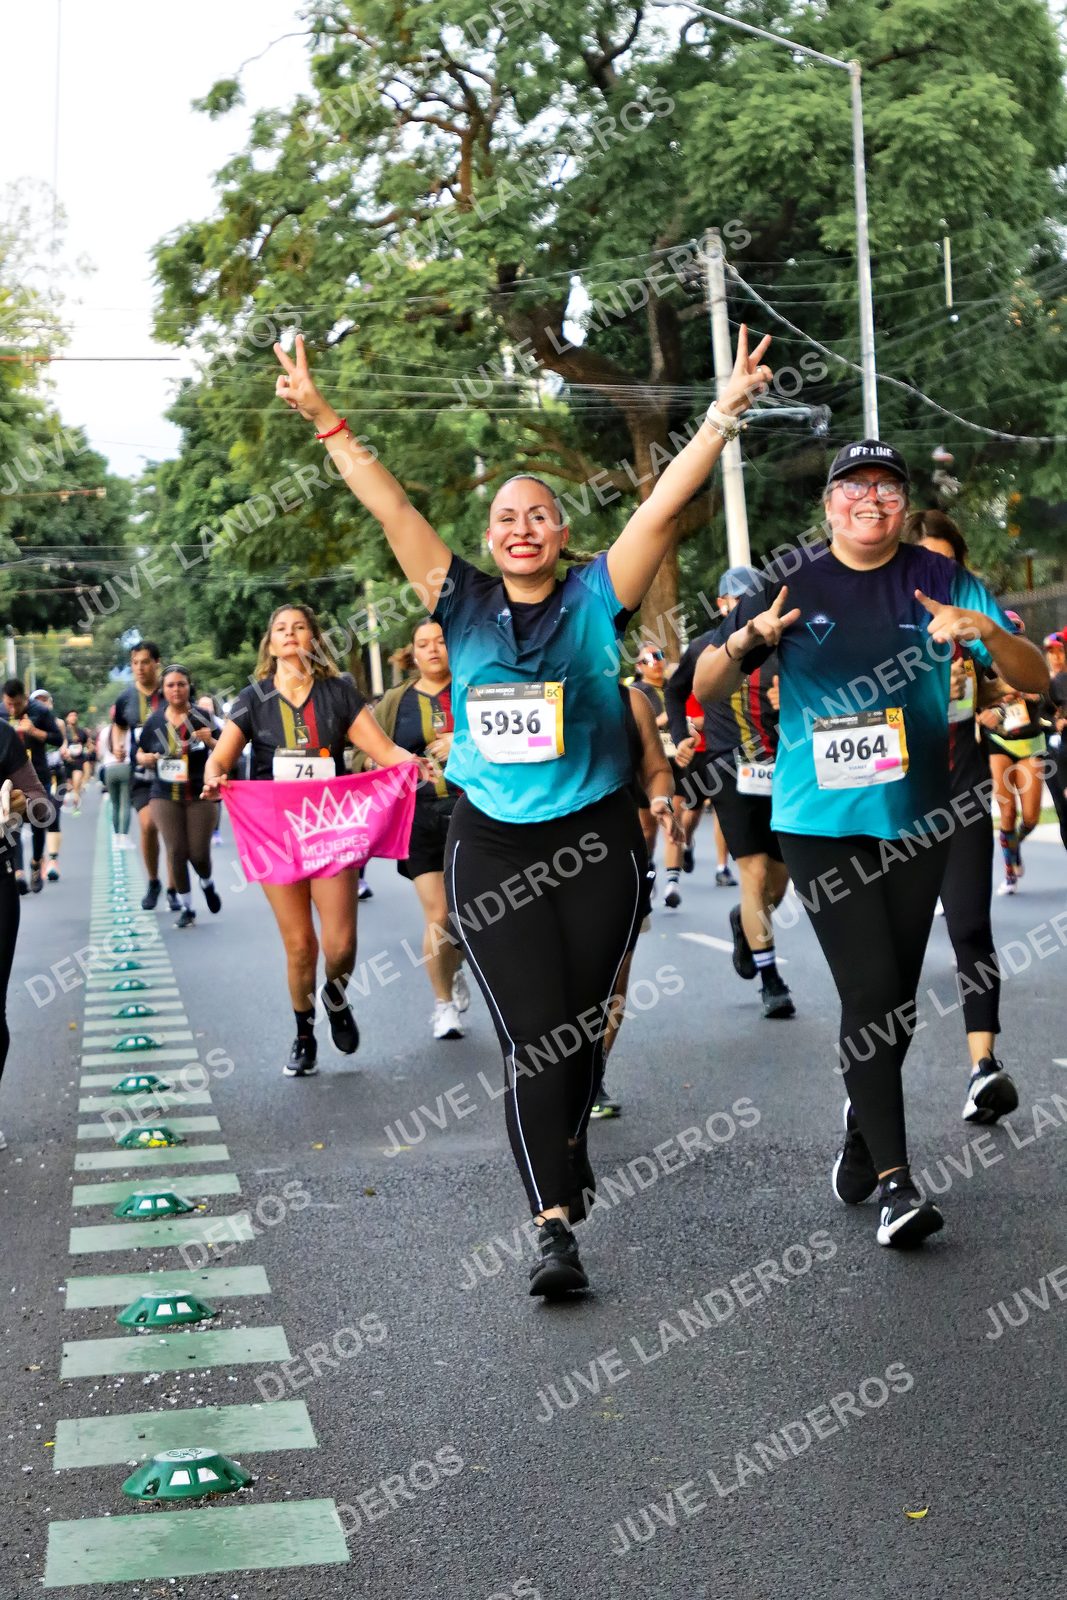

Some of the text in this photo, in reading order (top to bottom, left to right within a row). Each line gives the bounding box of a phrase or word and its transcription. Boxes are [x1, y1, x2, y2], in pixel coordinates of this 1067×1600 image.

[546, 689, 559, 698] 5K
[480, 709, 541, 736] 5936
[825, 735, 888, 763] 4964
[295, 764, 314, 779] 74
[301, 833, 370, 857] MUJERES
